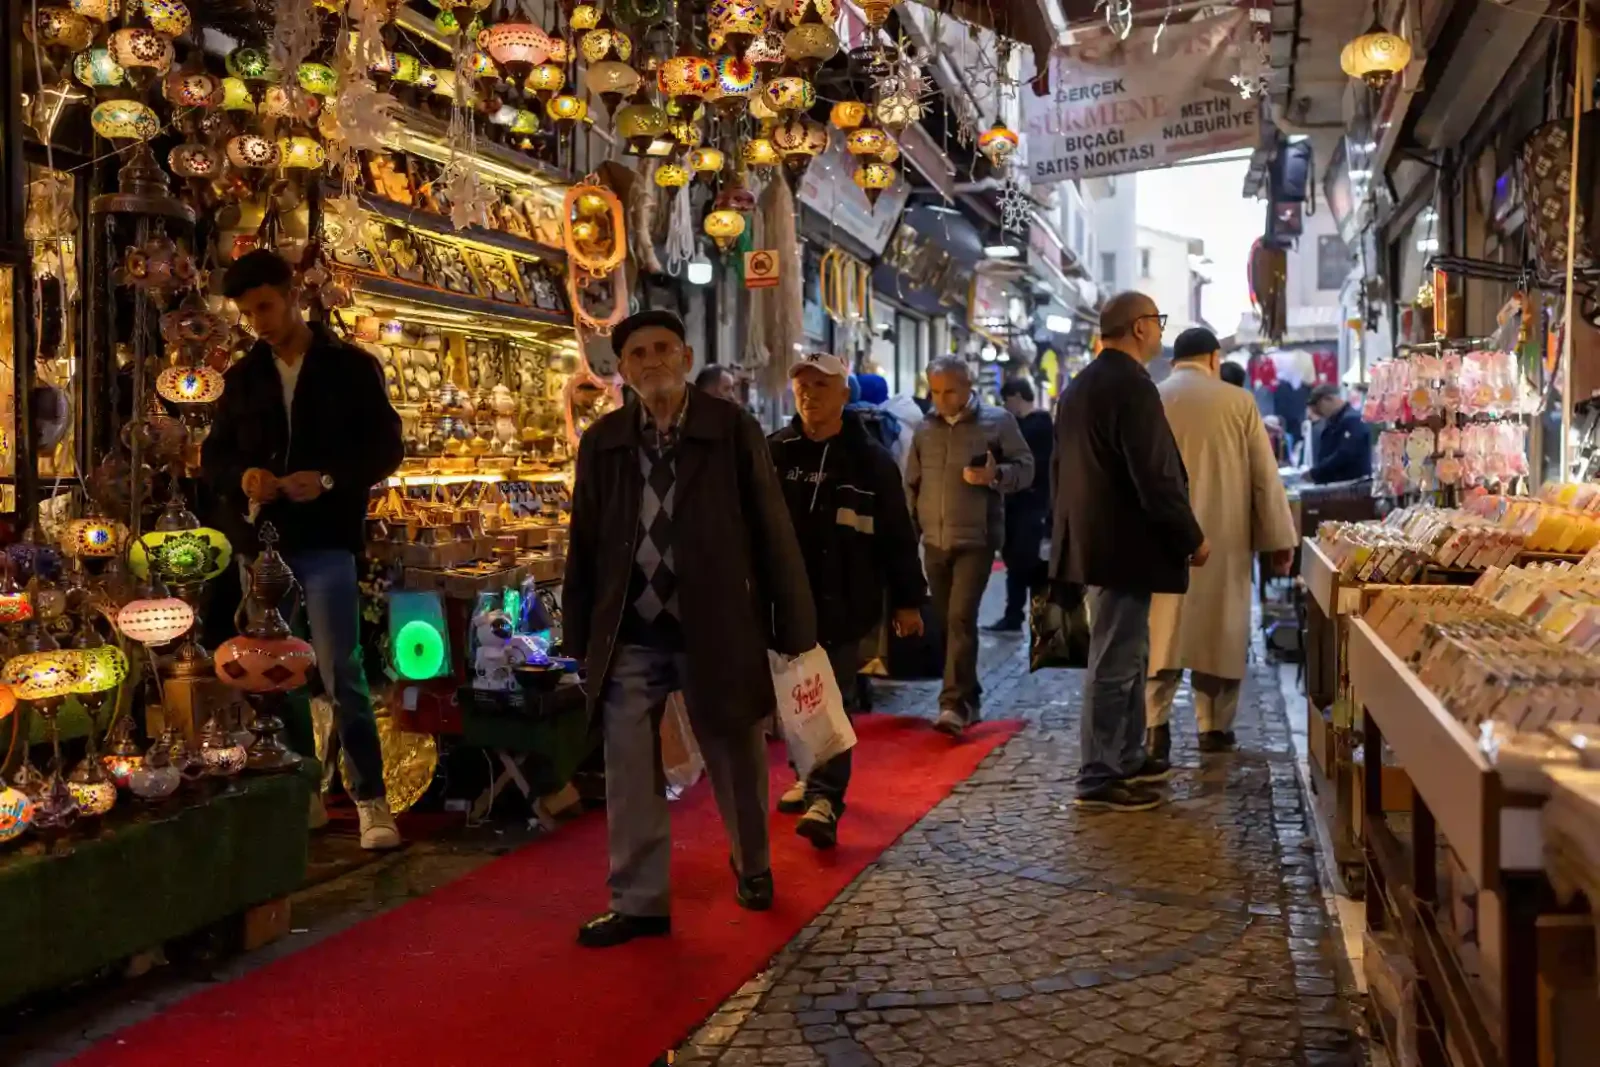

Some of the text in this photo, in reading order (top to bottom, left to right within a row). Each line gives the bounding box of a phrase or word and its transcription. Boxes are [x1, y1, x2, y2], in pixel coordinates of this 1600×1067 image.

[1055, 79, 1126, 103] GERÇEK
[1181, 95, 1231, 118] METİN
[1162, 109, 1254, 139] NALBURİYE
[1065, 128, 1124, 152] BIÇAĞI
[1036, 145, 1154, 176] SATIŞ NOKTASI
